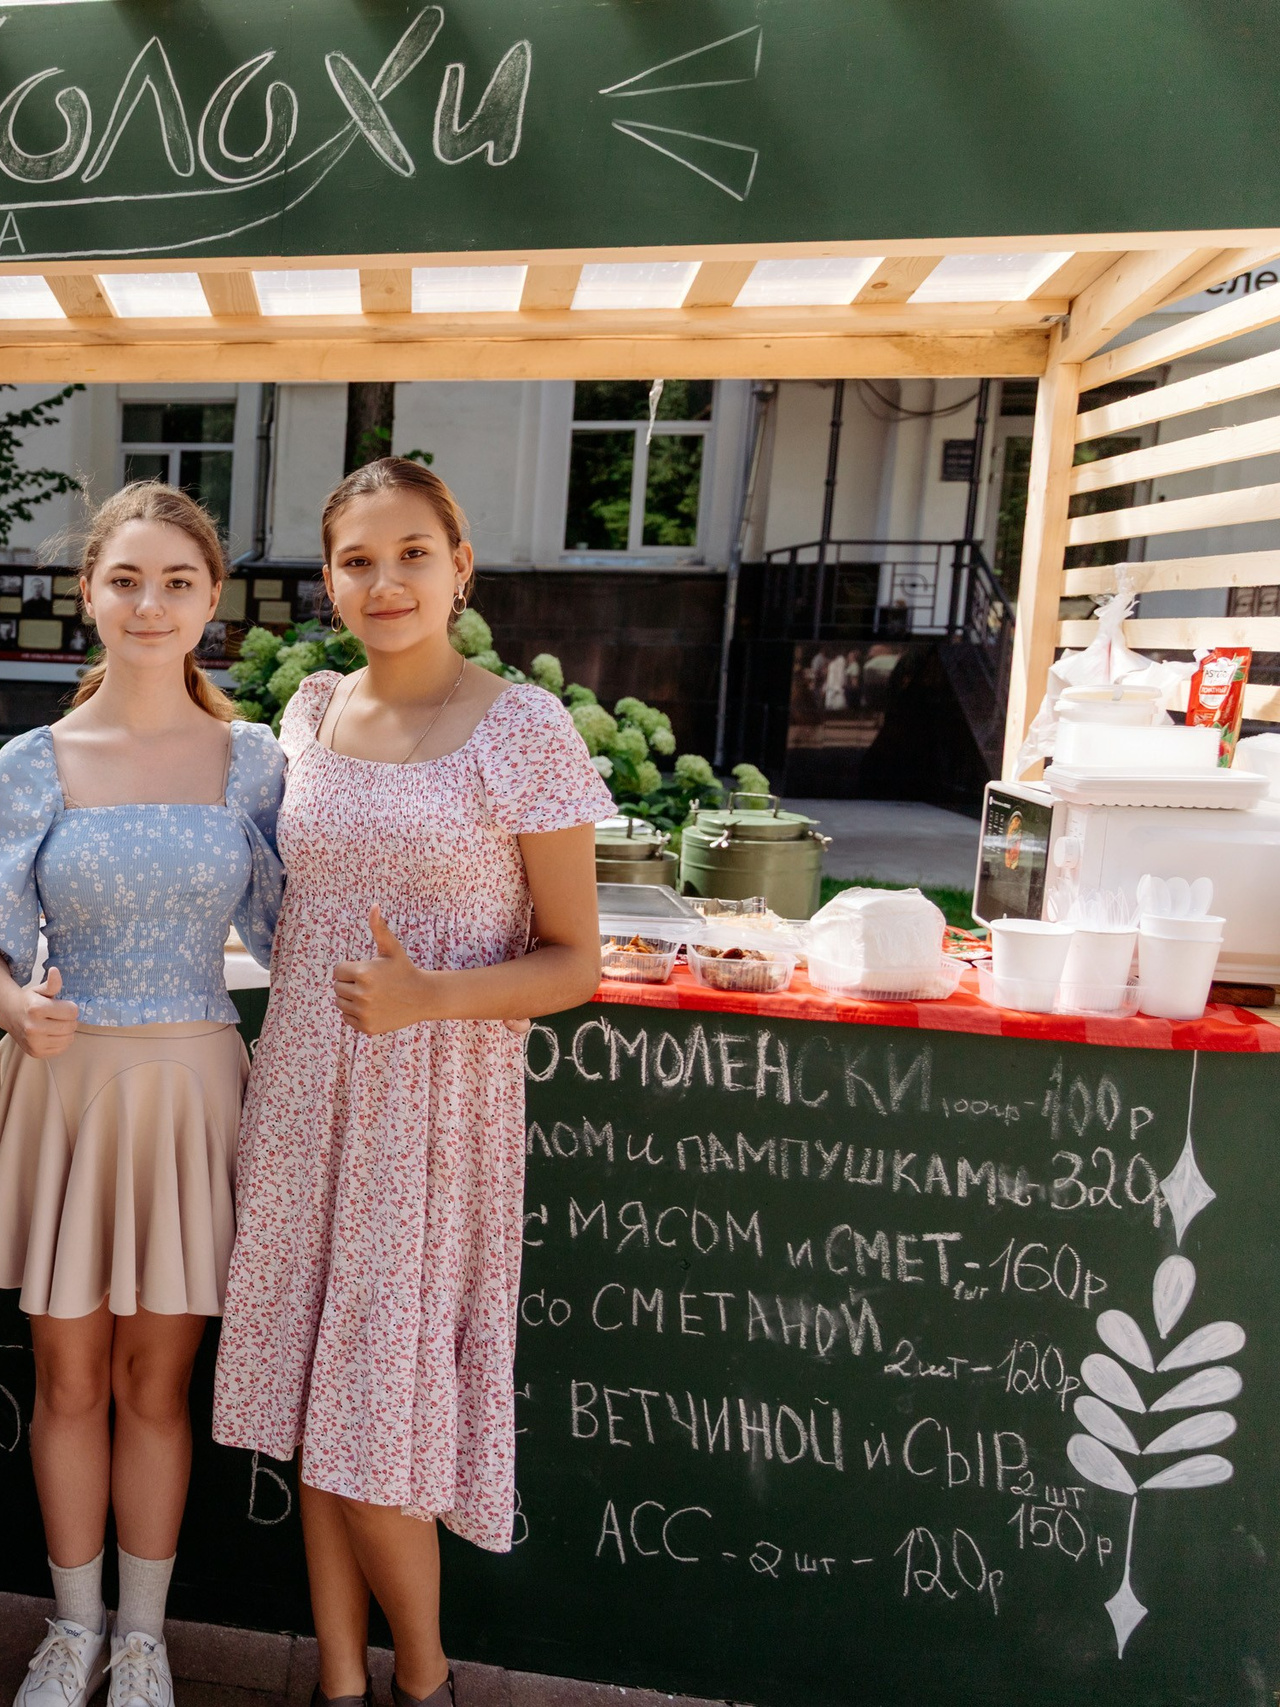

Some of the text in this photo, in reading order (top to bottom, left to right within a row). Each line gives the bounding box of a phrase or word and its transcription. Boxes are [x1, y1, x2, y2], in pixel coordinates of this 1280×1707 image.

[524, 1016, 933, 1117] О-СМОЛЕНСКИ
[525, 1117, 615, 1163] ЛОМ
[569, 1196, 763, 1257] МЯСОМ
[592, 1283, 883, 1357] СМЕТАНОЙ
[572, 1379, 844, 1472] ВЕТЧИНОЙ
[902, 1417, 1029, 1492] СЫР
[595, 1499, 712, 1565] АСС
